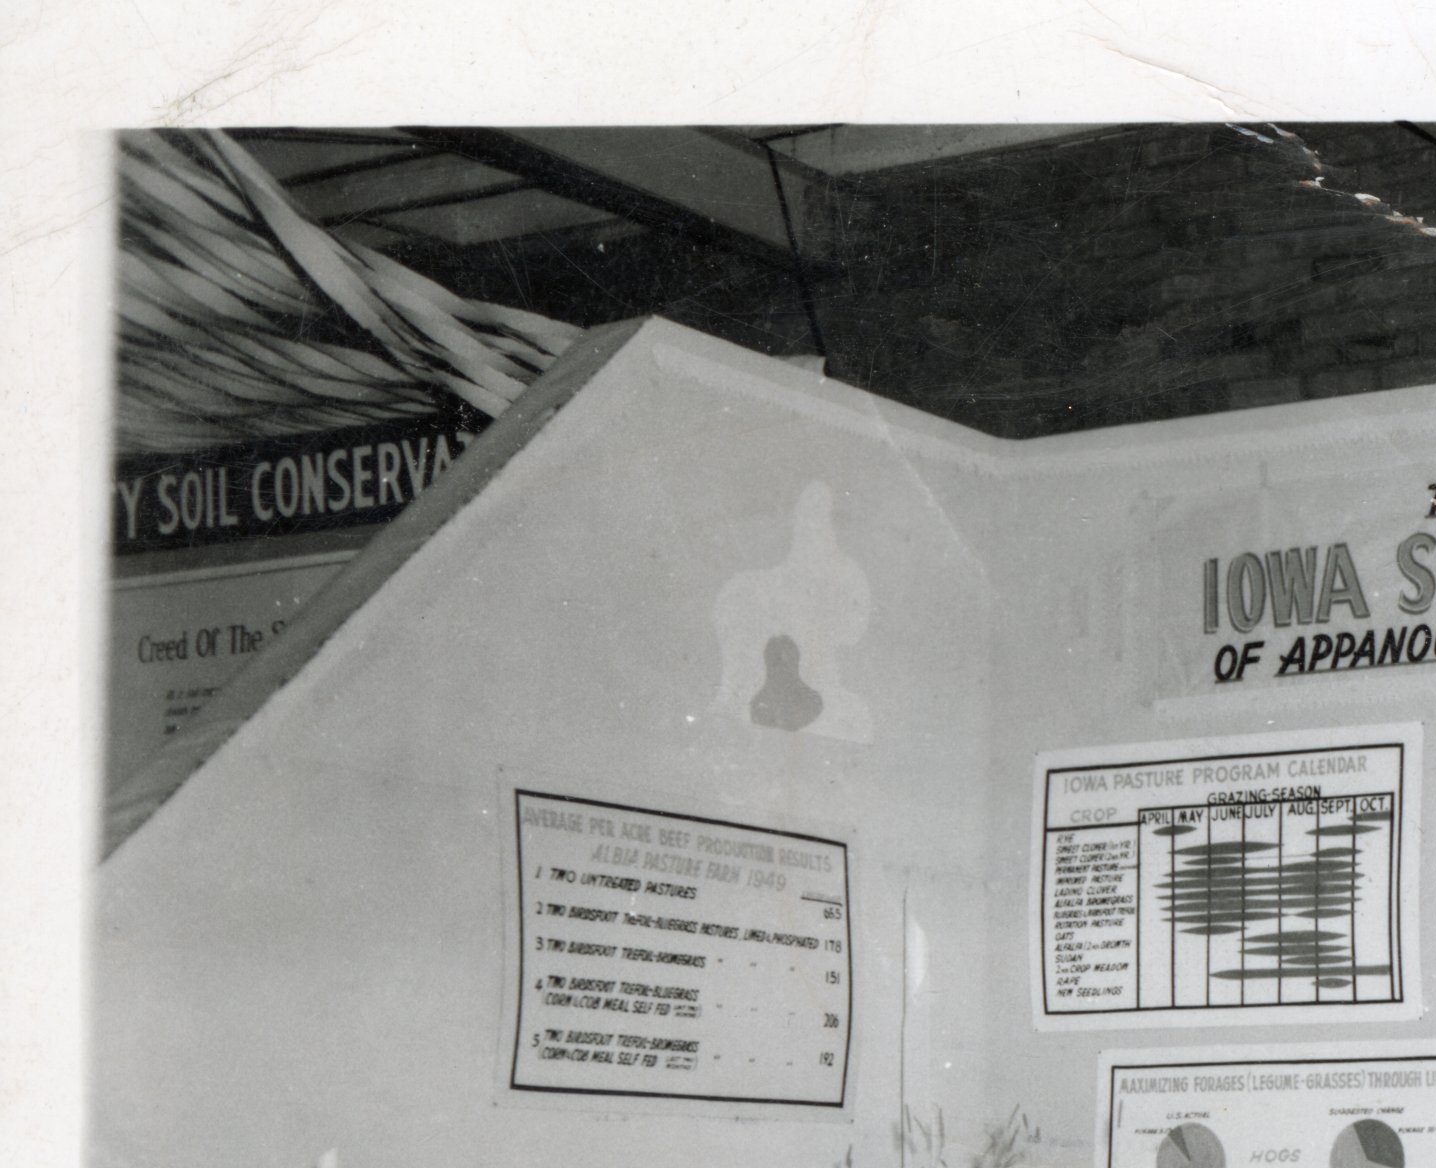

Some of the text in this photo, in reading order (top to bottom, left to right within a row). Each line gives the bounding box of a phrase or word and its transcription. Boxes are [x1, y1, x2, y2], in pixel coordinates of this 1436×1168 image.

[157, 466, 238, 535] SOIL
[252, 431, 476, 521] CONSERVA
[1204, 543, 1370, 633] IOWA
[138, 629, 188, 664] Creed
[195, 626, 218, 658] Of
[229, 623, 264, 655] The
[1215, 642, 1264, 681] OF
[1063, 756, 1367, 794] IOWA PASTURE PROGRAM CALENDAR
[1070, 808, 1117, 824] CROP
[1140, 811, 1171, 825] APRIL
[1178, 810, 1204, 824] MAY
[1212, 807, 1242, 821] JUNE
[1245, 804, 1276, 819] JULY
[523, 806, 584, 833] AVERAGE
[588, 816, 616, 838] PER
[621, 821, 652, 844] ACRE
[658, 828, 691, 849] BEEF
[778, 847, 833, 873] RESULTS
[747, 868, 787, 892] 1949
[1119, 1076, 1189, 1094] MAXIMIZING
[1194, 1075, 1245, 1092] FORAGES
[1368, 1071, 1422, 1089] THROUGH
[1250, 1149, 1302, 1163] HOGS
